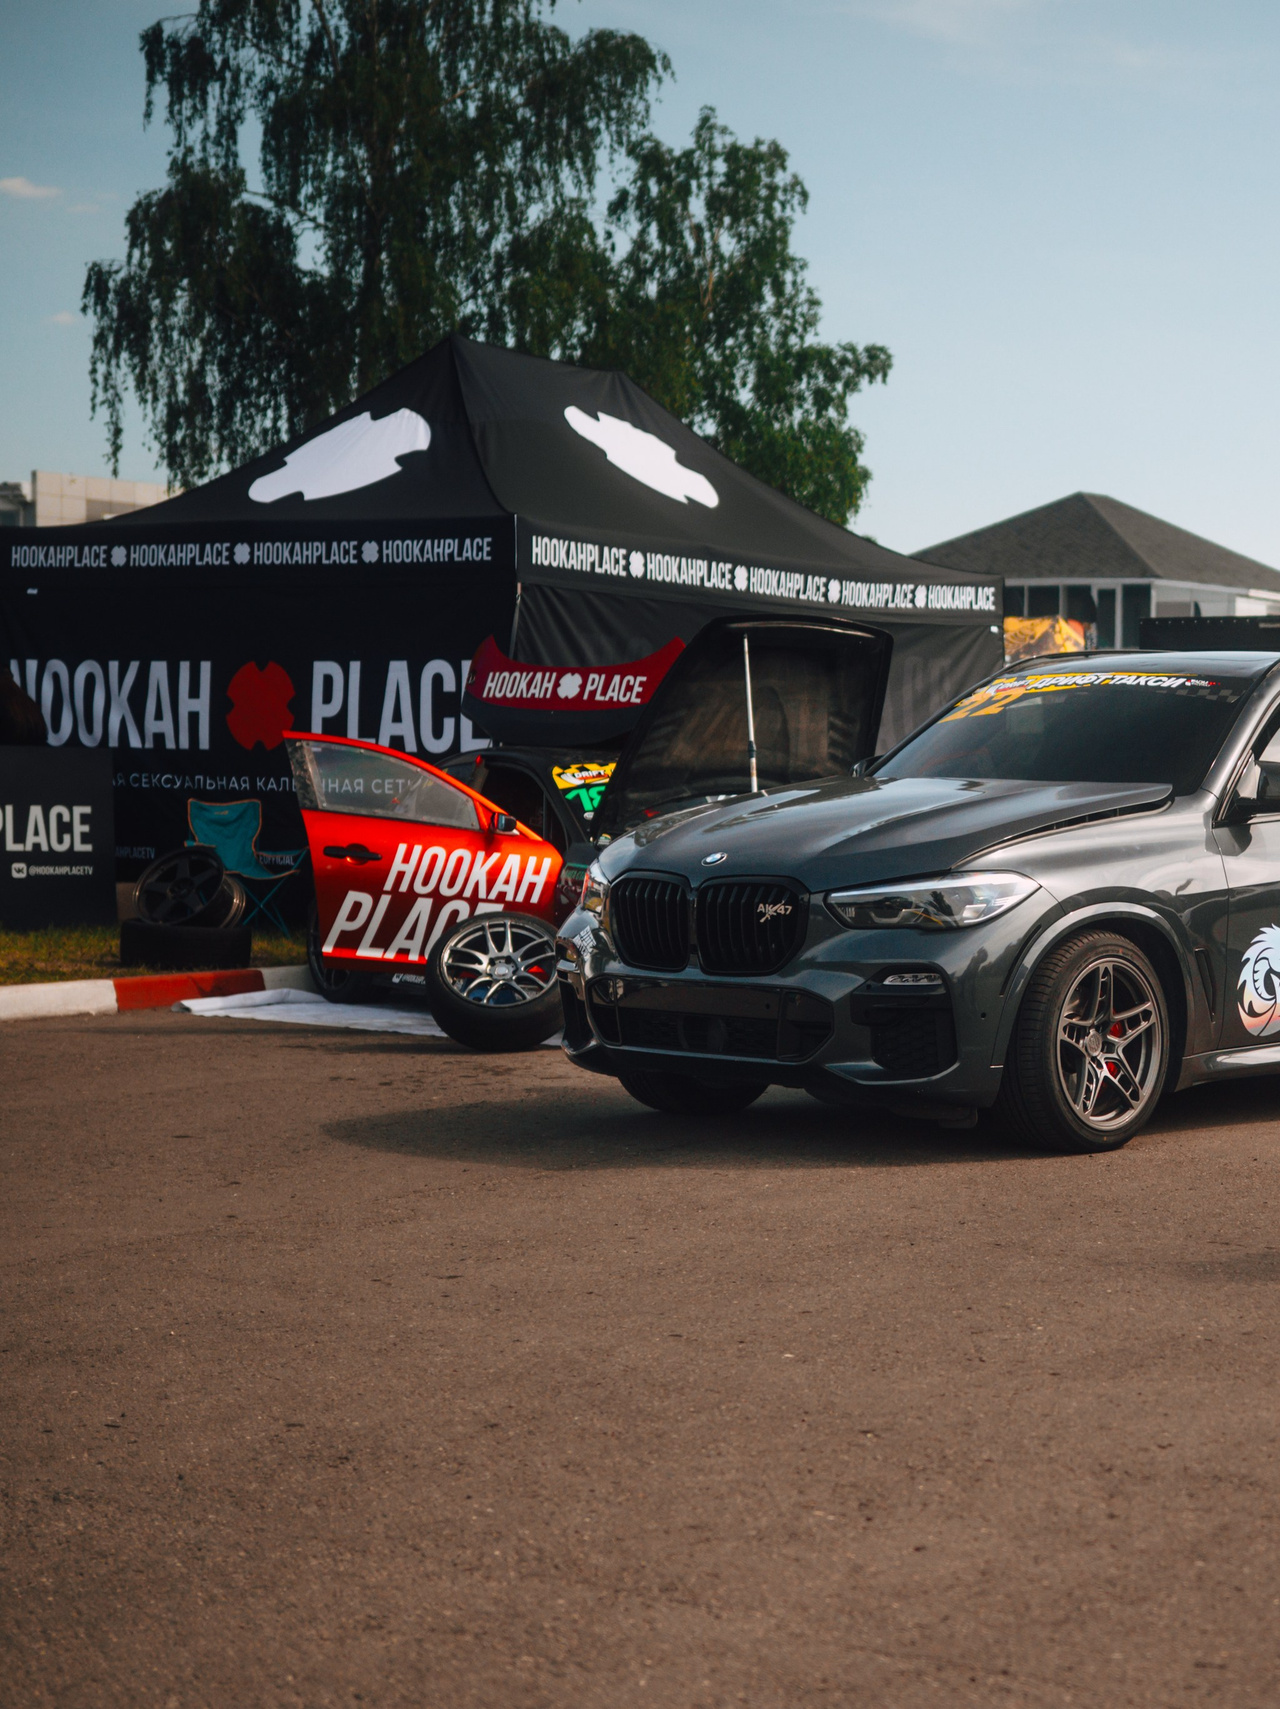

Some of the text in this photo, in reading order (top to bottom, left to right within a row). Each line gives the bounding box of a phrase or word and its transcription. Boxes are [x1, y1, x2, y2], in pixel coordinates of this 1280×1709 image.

[11, 537, 492, 568] HOOKAHPLACE HOOKAHPLACE HOOKAHPLACE HOOKAHPLACE
[532, 535, 996, 611] HOOKAHPLACE HOOKAHPLACE HOOKAHPLACE HOOKAHPLACE HOOKAHPLACE
[482, 671, 648, 704] HOOKAH PLACE
[129, 773, 250, 792] СЕКСУАЛЬНАЯ
[256, 775, 364, 794] КАЛНАЯ
[371, 779, 411, 795] СЕТ
[0, 804, 93, 852] LACE
[29, 865, 94, 877] @HOOKAHPLACETV
[383, 843, 552, 904] HOOKAH
[322, 890, 505, 962] PLAC
